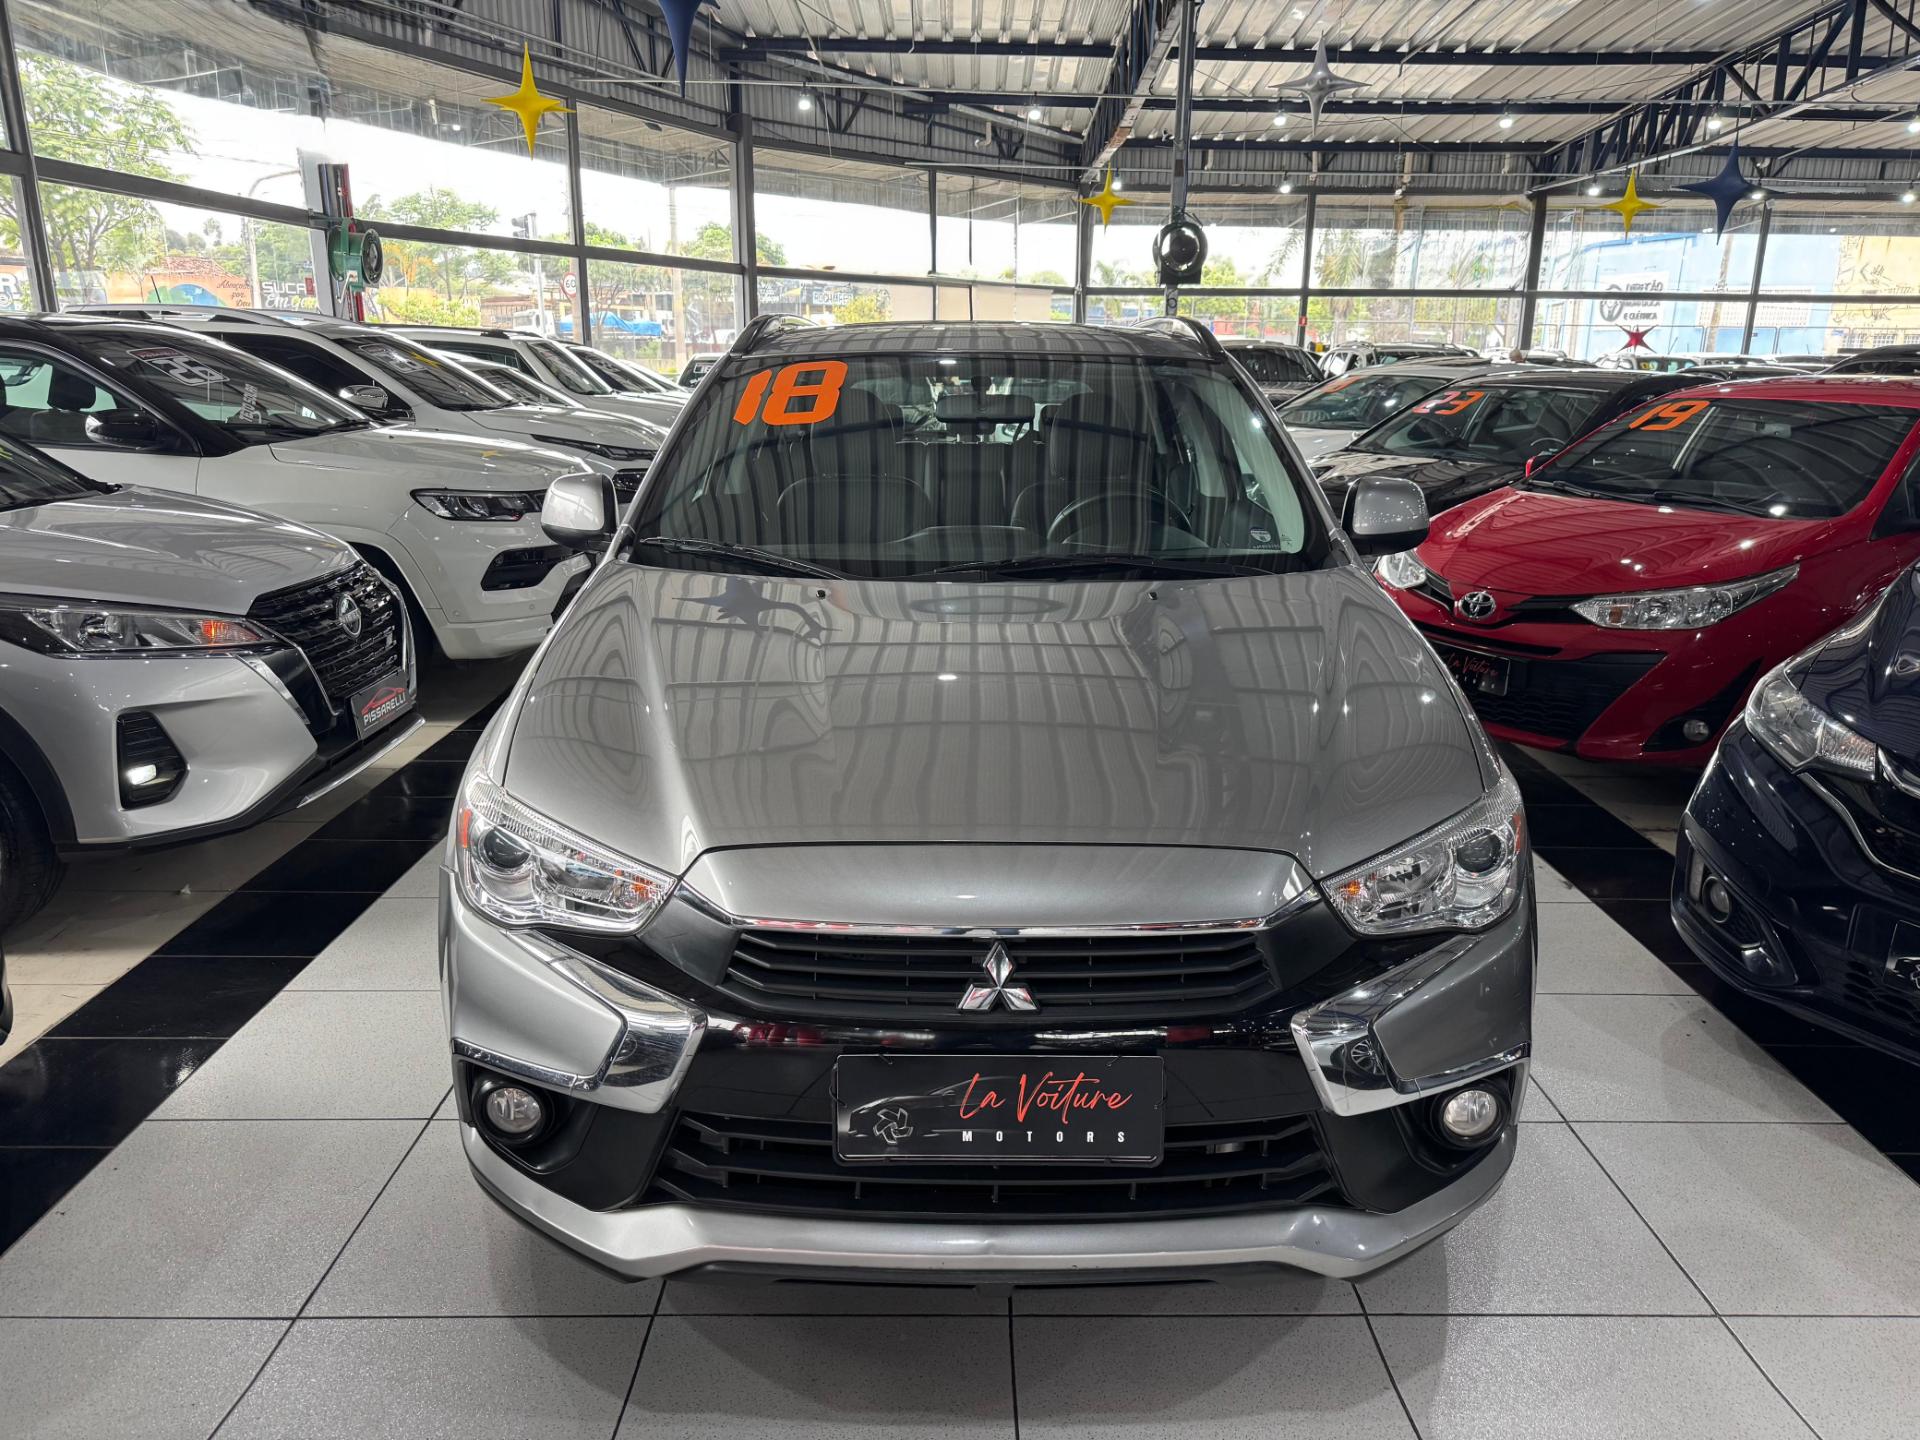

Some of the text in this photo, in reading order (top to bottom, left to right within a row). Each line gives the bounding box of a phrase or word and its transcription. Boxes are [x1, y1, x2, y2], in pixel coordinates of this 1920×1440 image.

[565, 279, 576, 288] 60
[152, 355, 224, 384] 26
[733, 360, 848, 426] 18
[1412, 391, 1485, 415] 23
[1629, 400, 1711, 431] 19
[363, 691, 406, 726] PISSARELLI
[959, 1071, 1133, 1125] La Voiture
[962, 1130, 1125, 1143] MOTORS
